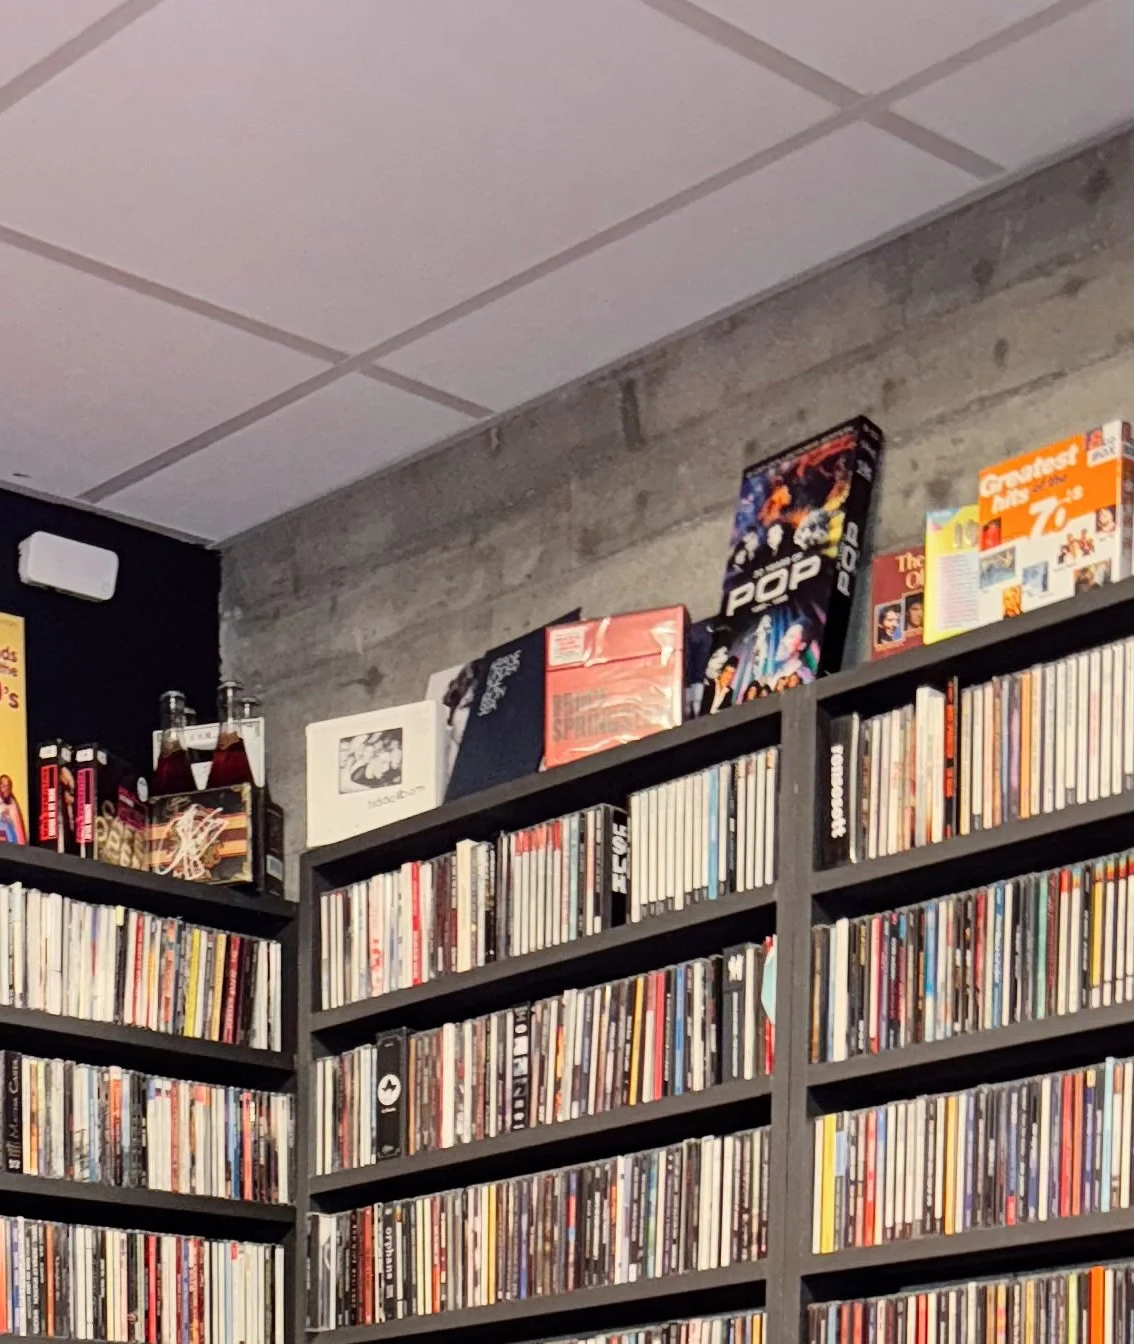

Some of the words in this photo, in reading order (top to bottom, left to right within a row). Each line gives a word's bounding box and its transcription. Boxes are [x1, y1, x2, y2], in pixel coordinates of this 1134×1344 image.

[979, 444, 1079, 497] Greatest
[992, 486, 1031, 514] hits
[725, 555, 822, 617] POP
[837, 521, 860, 597] POP
